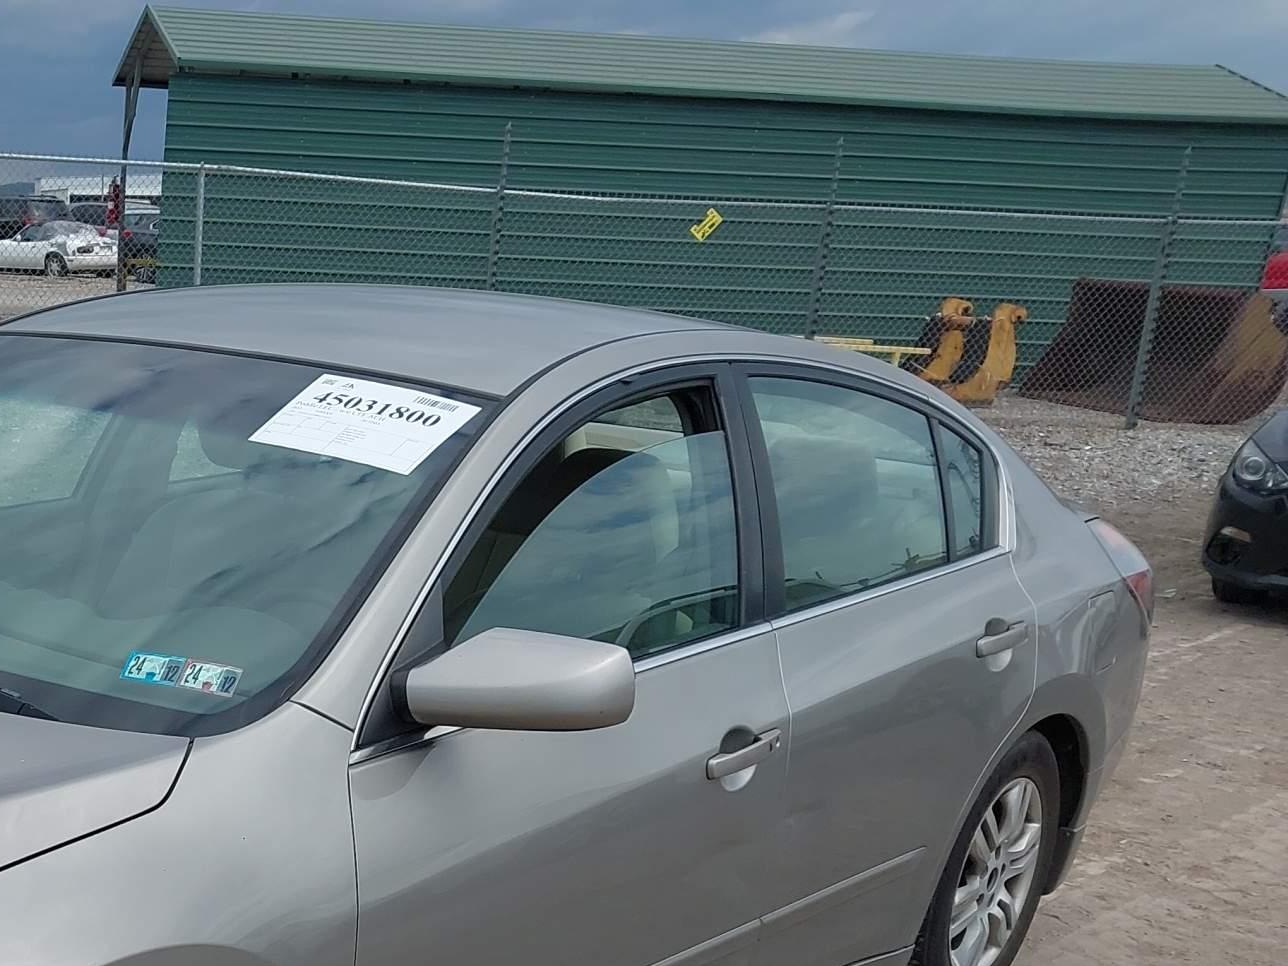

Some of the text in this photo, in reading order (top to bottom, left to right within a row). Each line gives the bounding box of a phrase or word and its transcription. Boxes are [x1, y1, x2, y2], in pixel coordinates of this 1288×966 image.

[313, 391, 442, 427] 45031800
[128, 656, 180, 682] 24 12
[185, 664, 237, 693] 24 12
